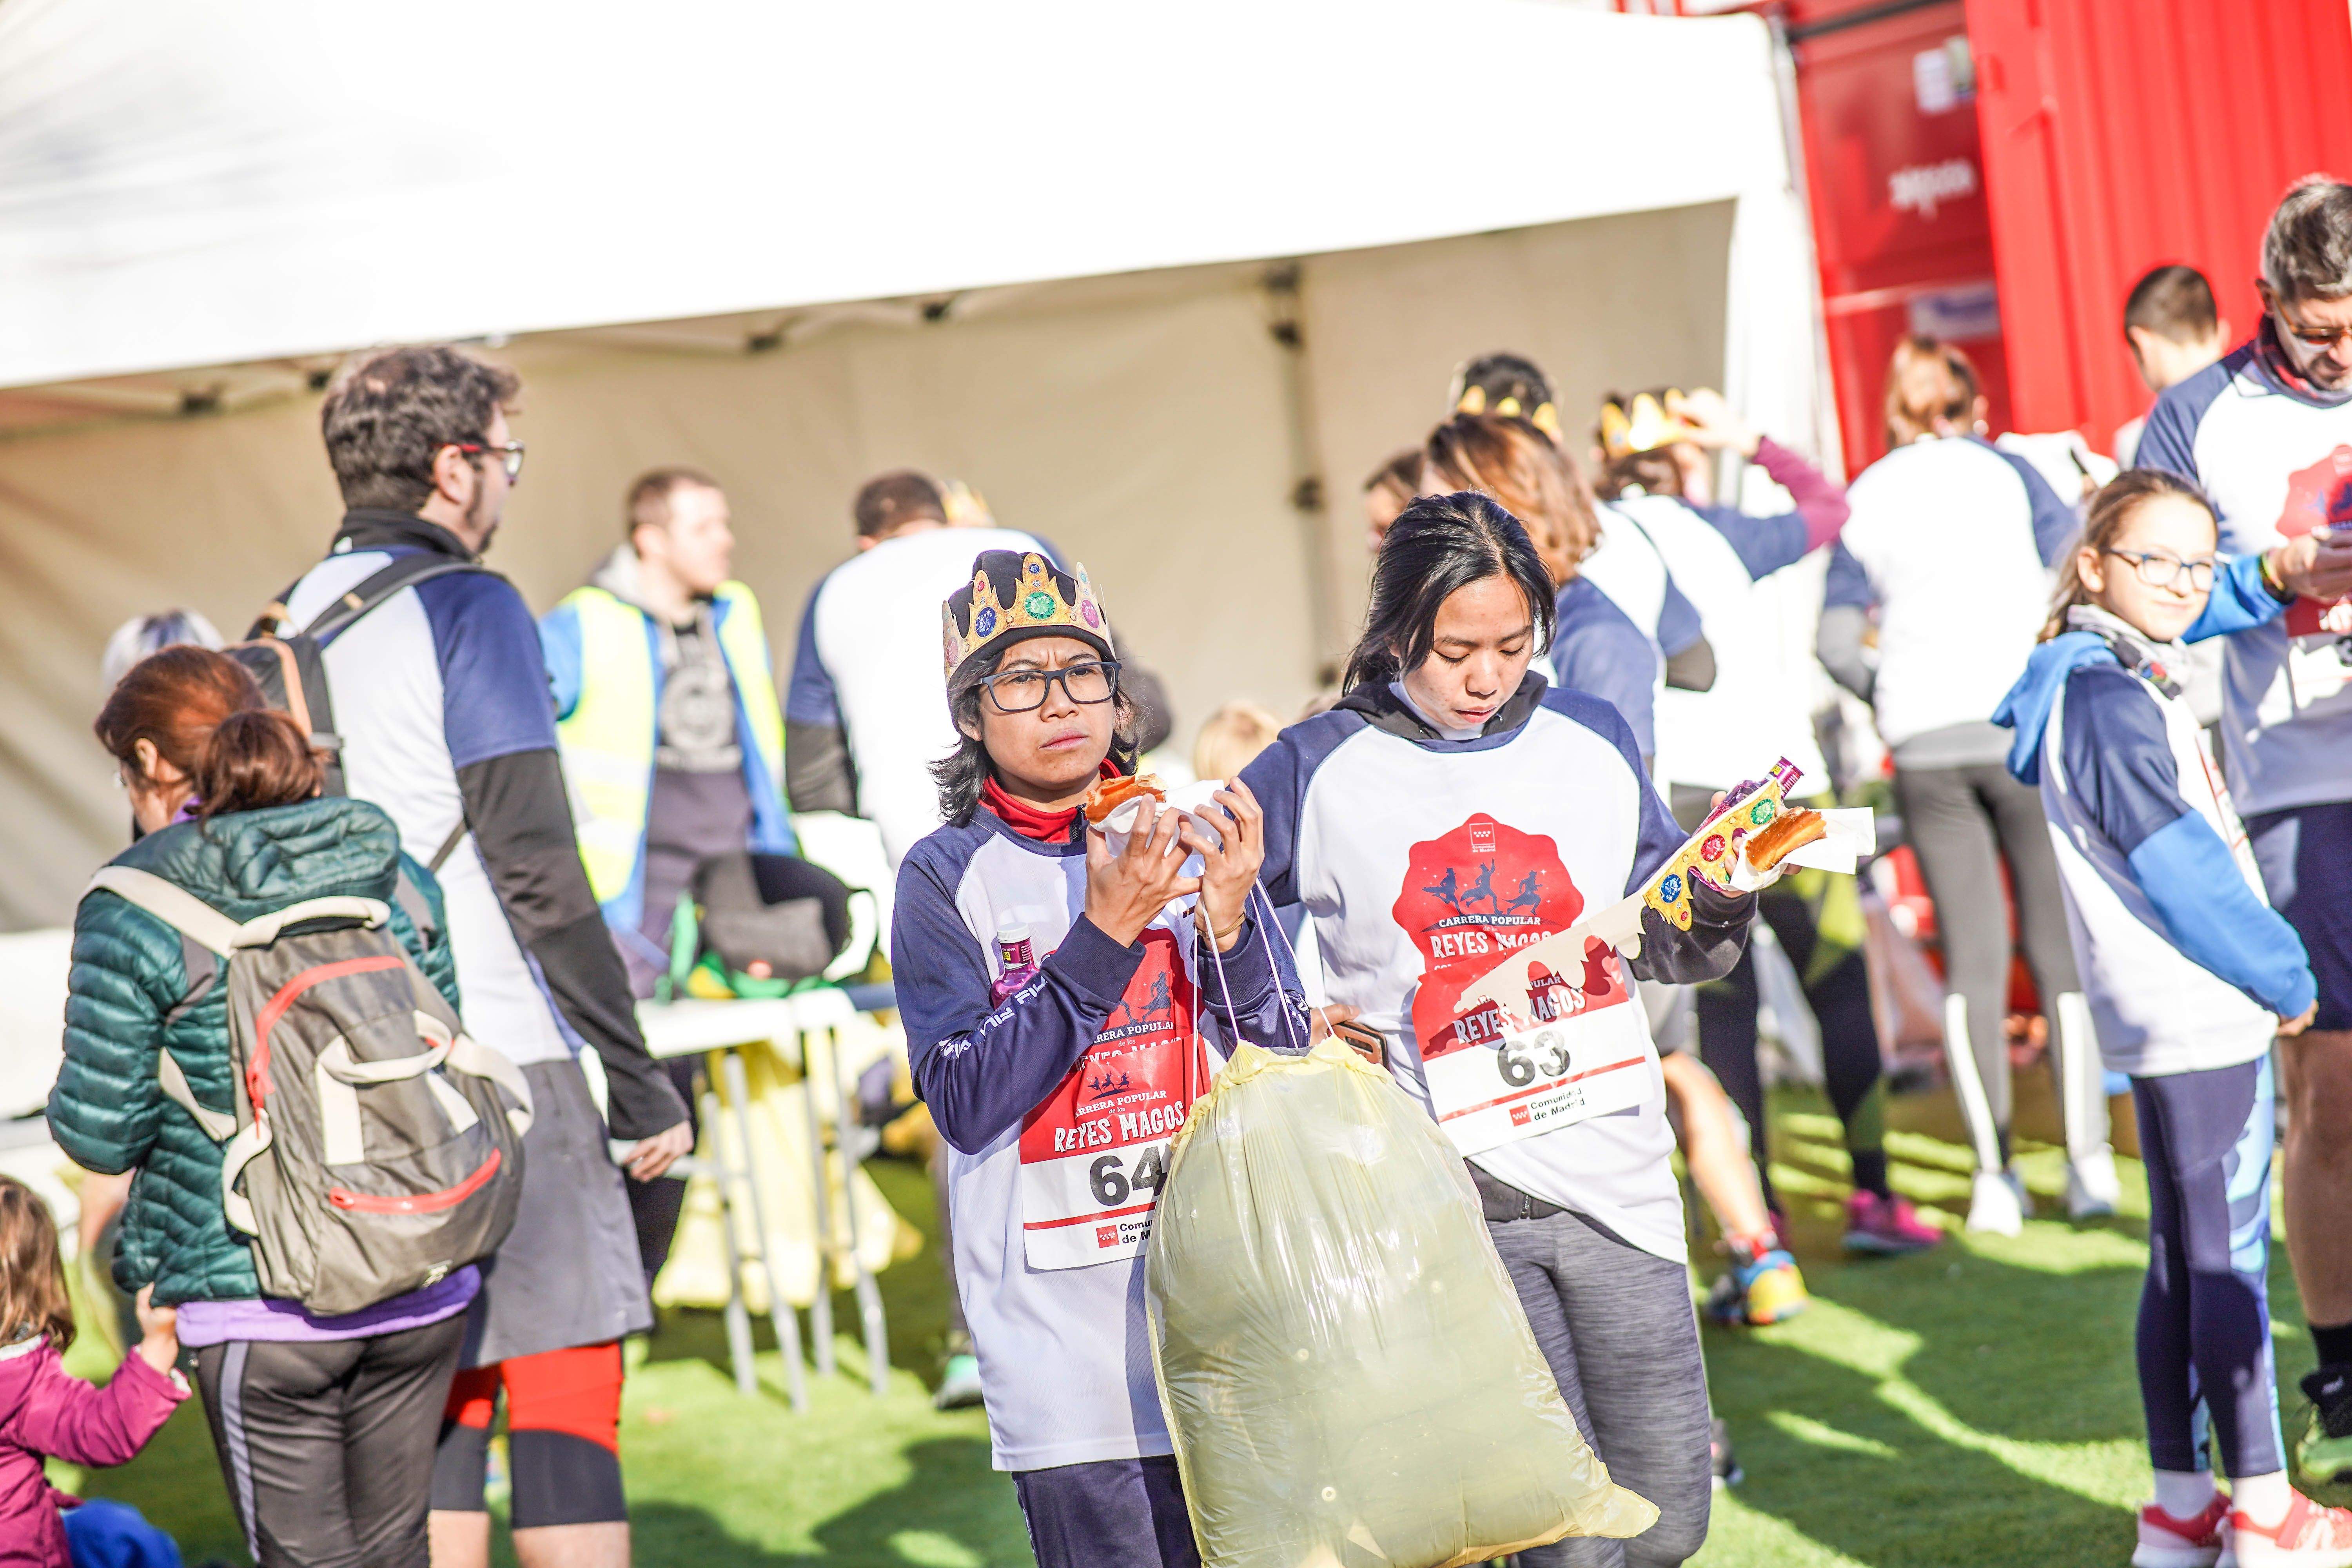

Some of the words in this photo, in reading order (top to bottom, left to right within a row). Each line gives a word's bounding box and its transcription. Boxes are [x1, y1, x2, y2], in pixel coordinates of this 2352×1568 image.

[1439, 915, 1489, 927] CARRERA
[1491, 916, 1541, 926] POPULAR
[1430, 931, 1489, 958] REYES
[1453, 1006, 1515, 1044] REYES
[1497, 1030, 1571, 1087] 63
[1117, 1090, 1167, 1106] POPULAR
[1054, 1118, 1112, 1153] REYES
[1118, 1100, 1185, 1142] MAGOS
[1534, 1112, 1547, 1121] de
[1089, 1146, 1168, 1206] 64
[1122, 1234, 1137, 1244] de
